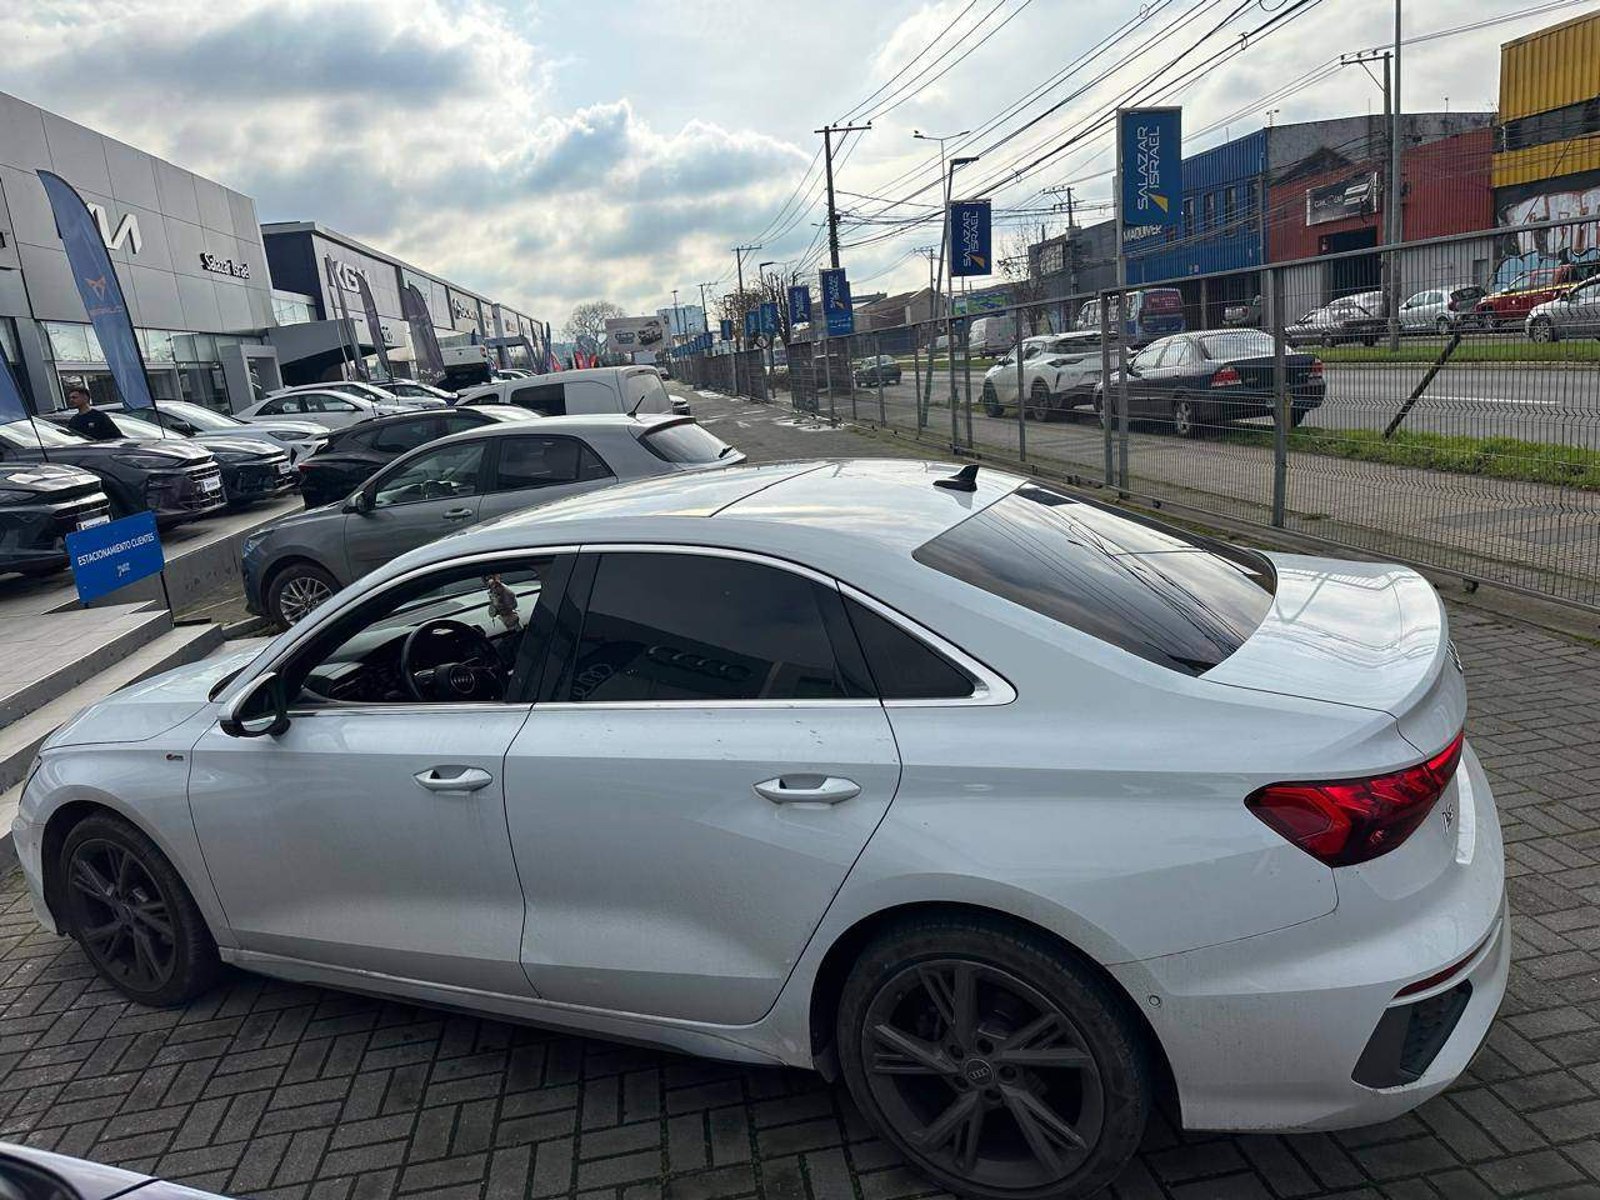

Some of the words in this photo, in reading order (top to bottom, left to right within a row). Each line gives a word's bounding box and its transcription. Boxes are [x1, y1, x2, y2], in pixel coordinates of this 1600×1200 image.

[1137, 126, 1149, 210] SALAZAR
[1148, 125, 1160, 189] ISRAEL
[962, 211, 972, 267] SALAZAR
[970, 210, 979, 252] ISRAEL
[77, 541, 131, 566] ESTACIONAMIENTO
[130, 532, 154, 548] CLIENTES
